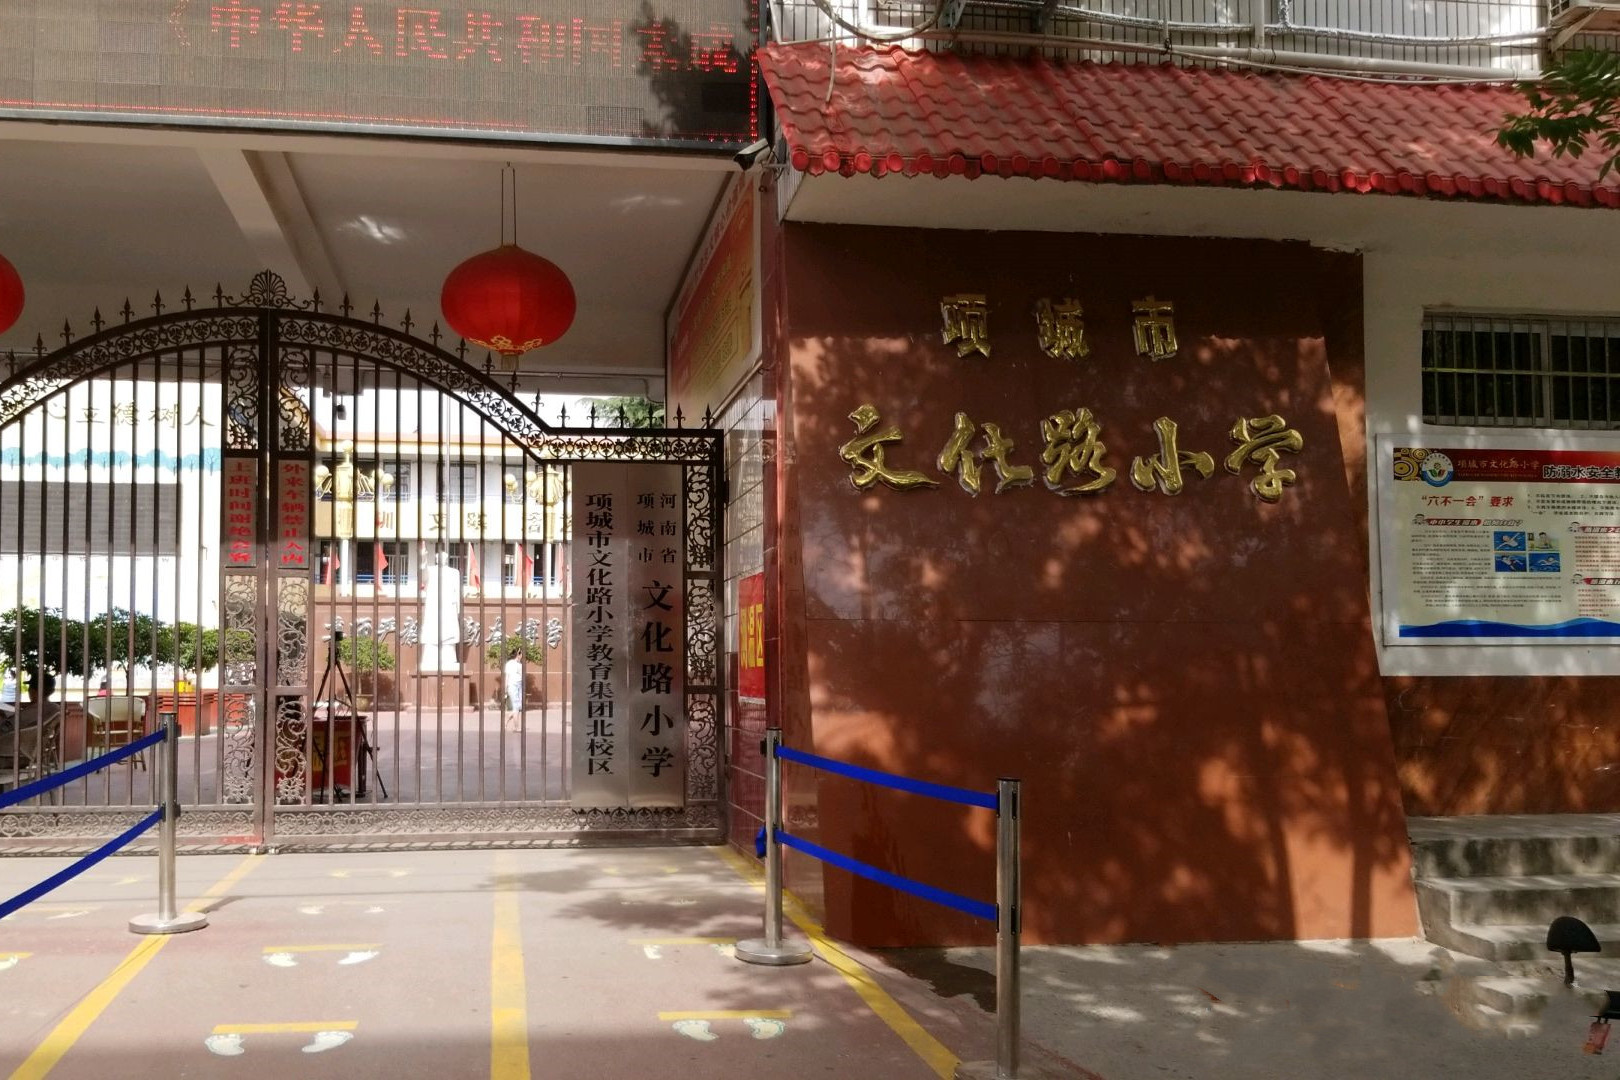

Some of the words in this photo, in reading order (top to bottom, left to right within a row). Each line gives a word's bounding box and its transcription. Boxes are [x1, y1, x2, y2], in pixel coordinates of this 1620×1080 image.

[281, 463, 305, 565] 外来车辆禁止入内
[637, 493, 656, 564] 项城市
[659, 492, 677, 565] 河南省
[584, 493, 614, 776] 项城市文化路小学教育集团北校区
[640, 580, 674, 778] 文化路小学
